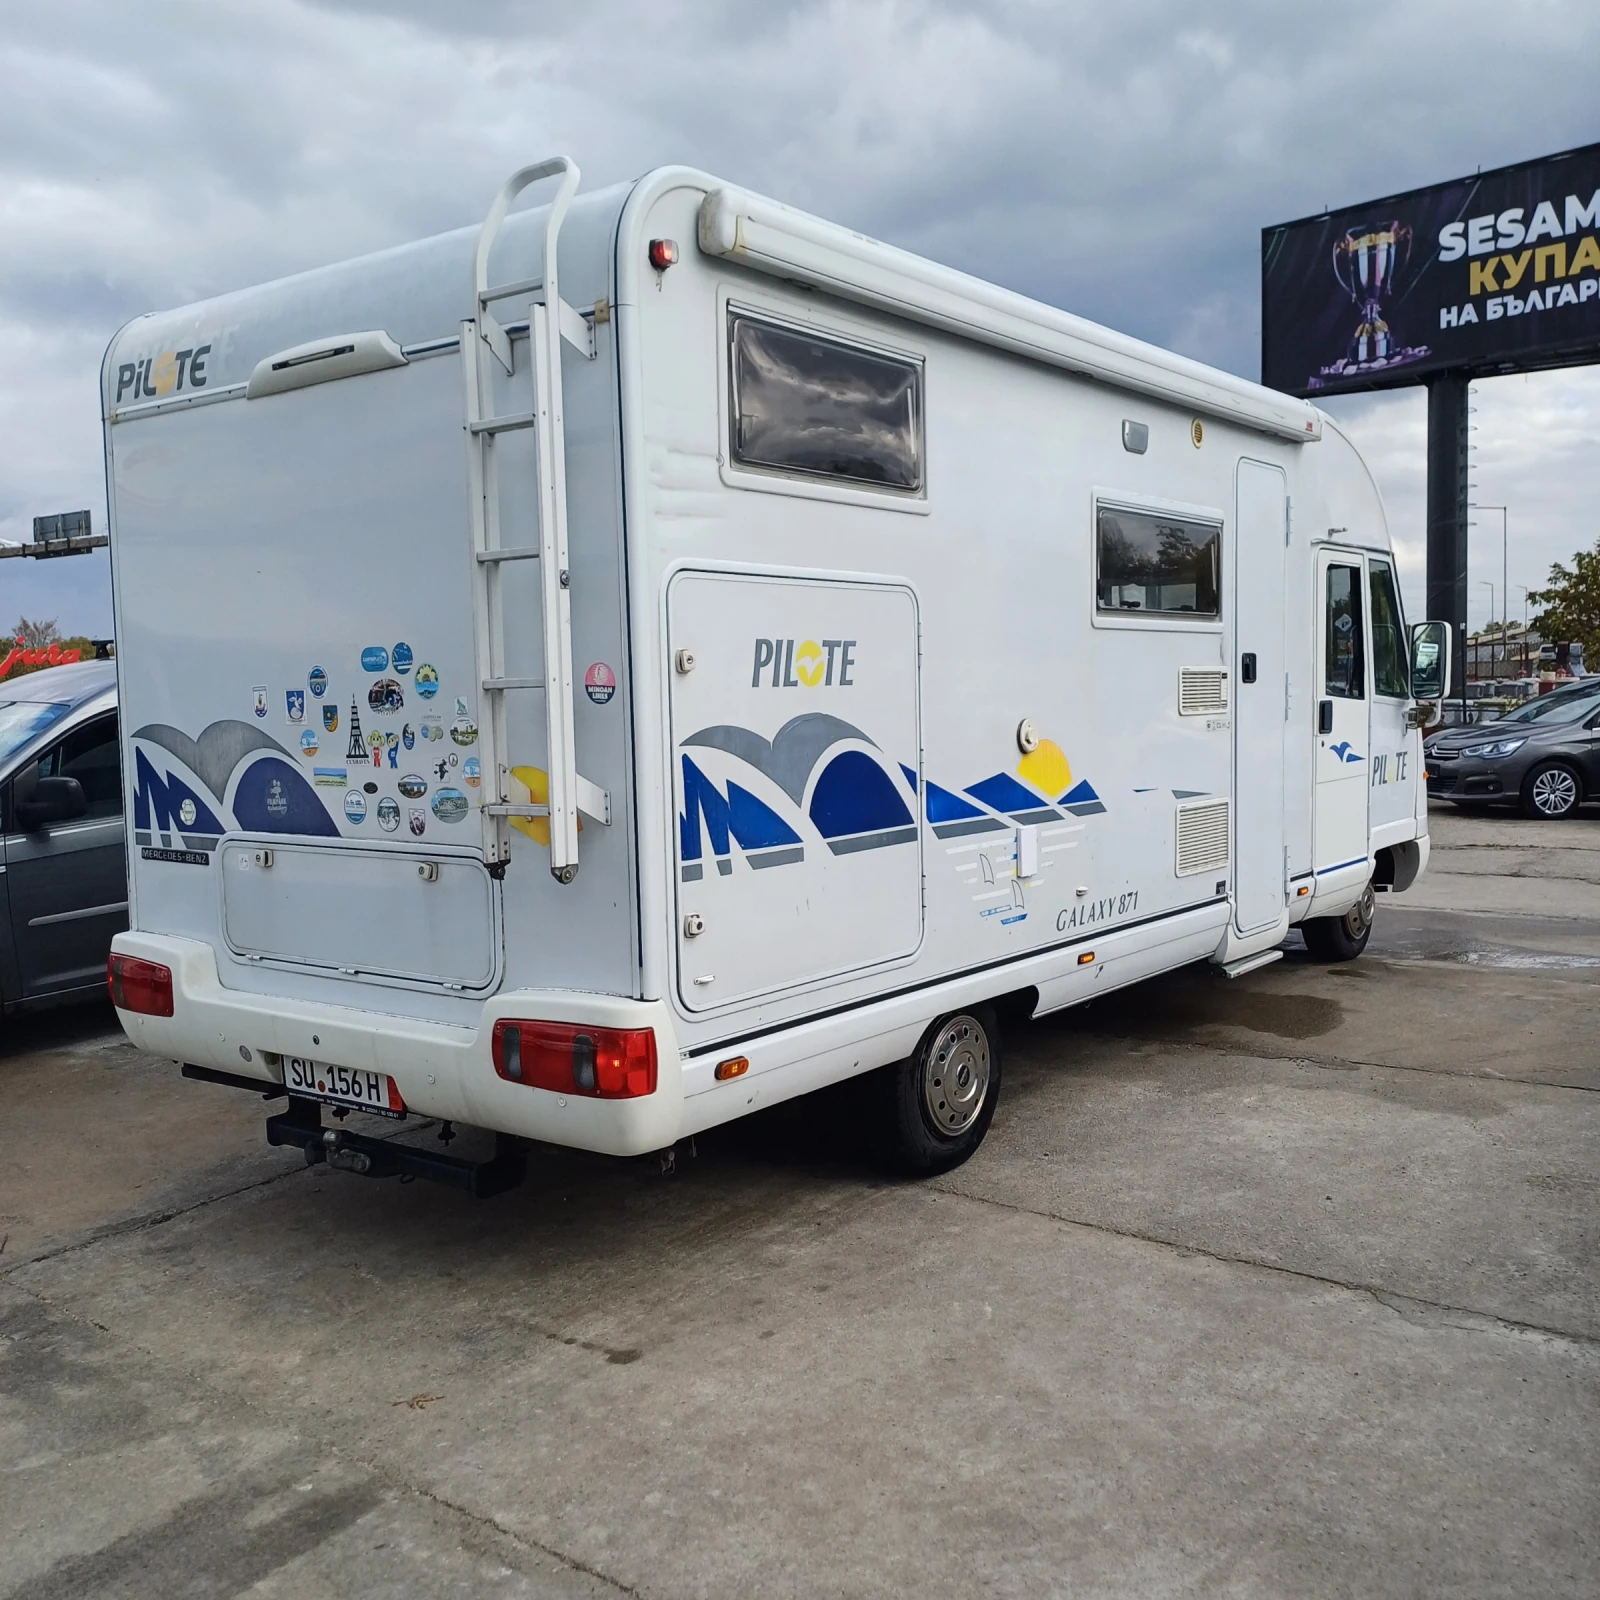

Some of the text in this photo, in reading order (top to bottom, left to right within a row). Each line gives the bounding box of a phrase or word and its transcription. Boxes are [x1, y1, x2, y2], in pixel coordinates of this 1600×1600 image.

[1438, 188, 1600, 262] SESAM
[1470, 235, 1600, 296] КУПА
[1440, 278, 1600, 329] НА БЪЛГАР
[751, 638, 857, 688] PILOTE
[142, 849, 206, 864] MERCEDES-BENZ
[1056, 890, 1139, 932] GALAXY 871
[291, 1059, 316, 1089] SU
[326, 1065, 363, 1098] 156
